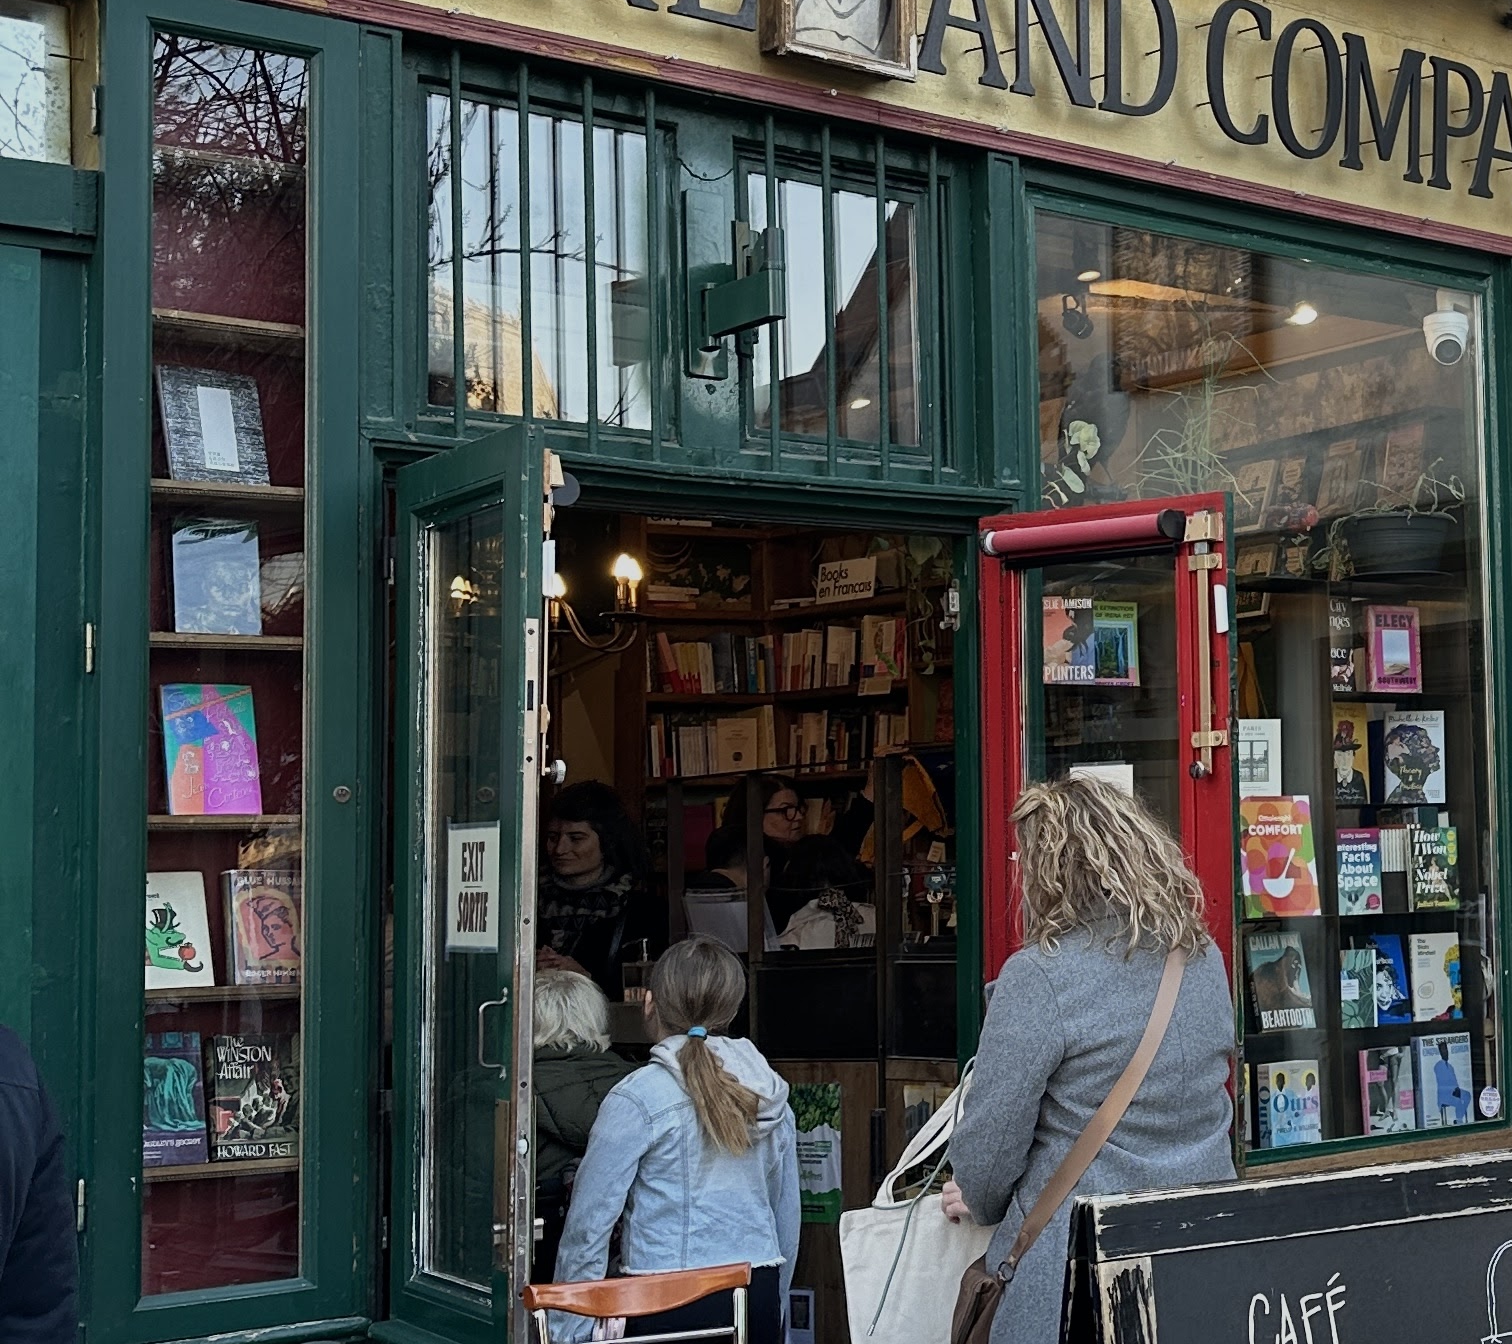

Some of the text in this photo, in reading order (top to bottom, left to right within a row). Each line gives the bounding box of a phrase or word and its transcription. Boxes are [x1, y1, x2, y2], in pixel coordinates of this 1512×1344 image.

[820, 562, 849, 582] Books
[818, 587, 831, 598] en
[1248, 824, 1304, 836] COMFORT
[1413, 830, 1441, 843] How
[1414, 843, 1447, 856] I Won
[461, 841, 486, 883] EXIT
[1341, 852, 1371, 863] Facts
[1340, 864, 1374, 875] About
[1415, 868, 1448, 882] Nobel
[1337, 875, 1379, 891] Space
[1416, 882, 1447, 894] Prize
[456, 891, 489, 933] SORTIE
[1261, 1007, 1316, 1030] BEARTOOTH
[222, 1035, 245, 1048] The
[1421, 1037, 1434, 1046] THE
[216, 1045, 272, 1063] WINSTON
[215, 1062, 255, 1080] Affair
[1272, 1093, 1319, 1114] Ours
[217, 1143, 293, 1160] HOWARD FAST
